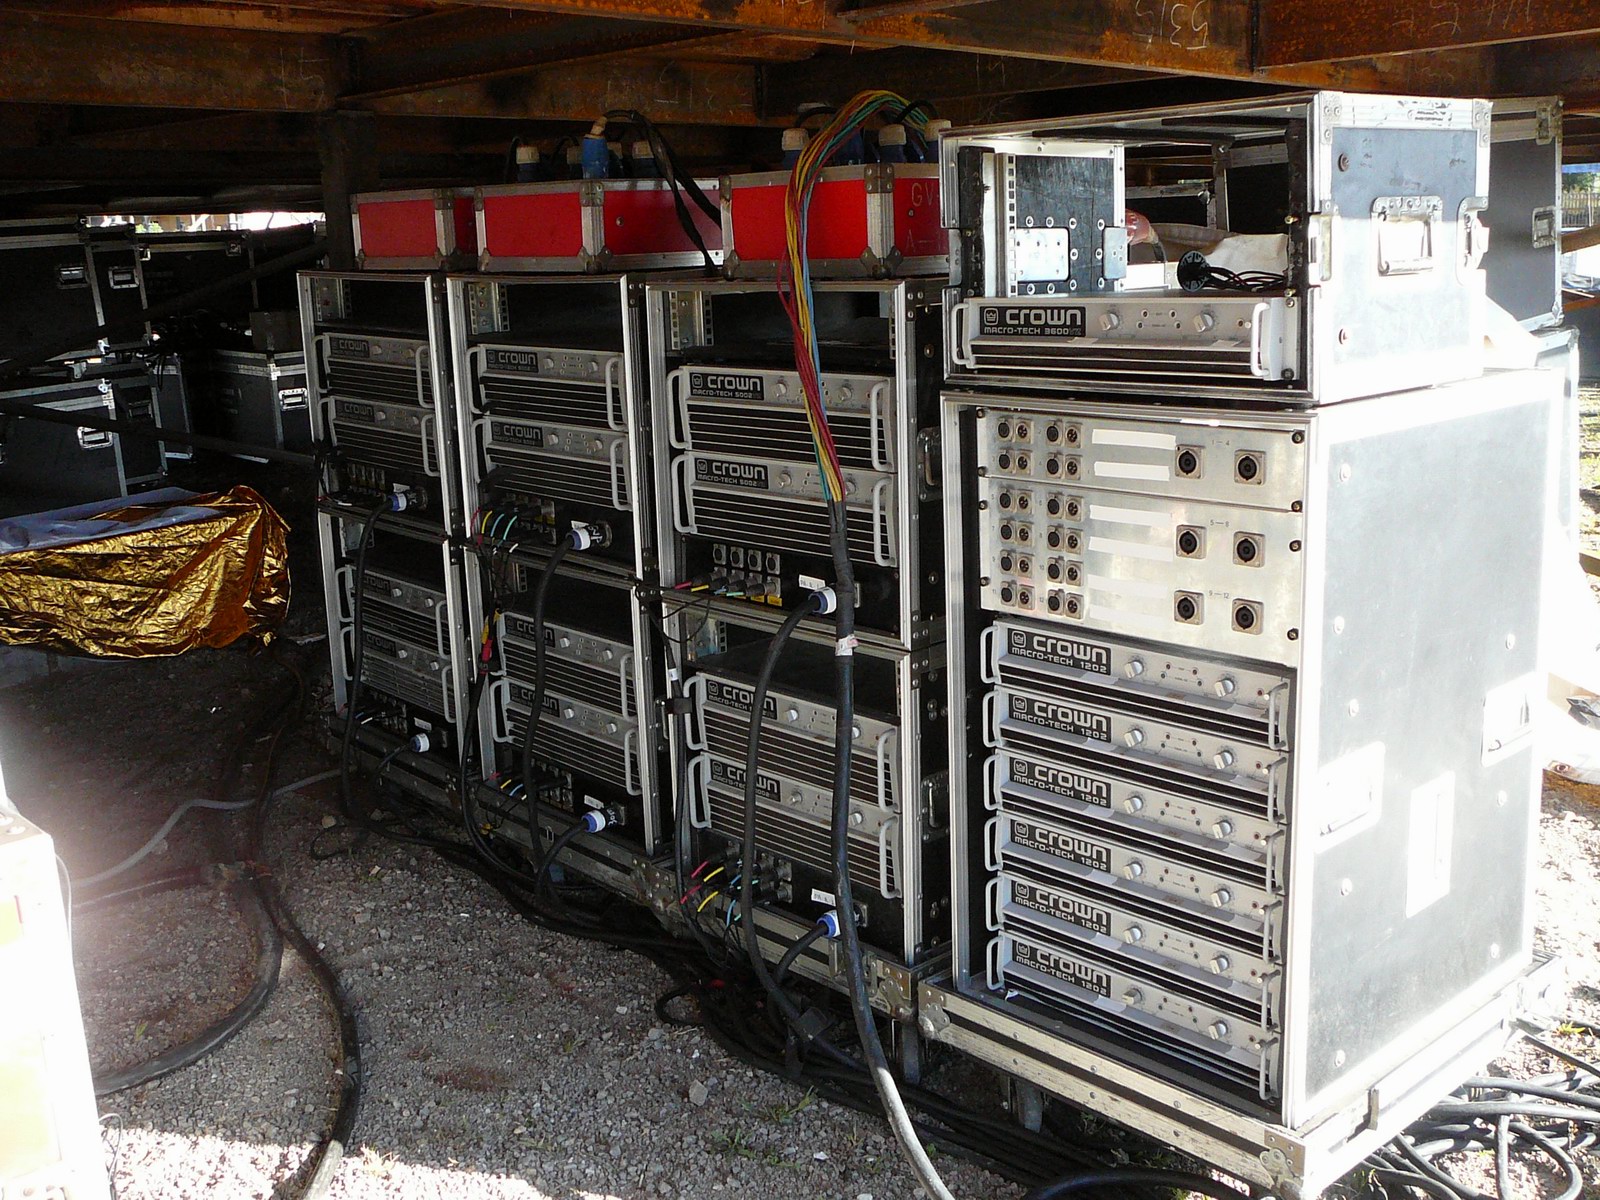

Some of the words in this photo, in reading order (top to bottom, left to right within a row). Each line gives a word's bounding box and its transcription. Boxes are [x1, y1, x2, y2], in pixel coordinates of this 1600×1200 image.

[984, 327, 1041, 335] MACRO-TECH
[692, 389, 733, 397] MACRO-TECH
[697, 474, 738, 485] MACRO-TECH
[1011, 646, 1074, 667] MACRO-TECH
[1080, 661, 1108, 674] 1202
[708, 695, 748, 711] MACRO-TECH
[1012, 711, 1075, 733] MACRO-TECH
[1081, 726, 1108, 740] 1202
[1013, 774, 1075, 798] MACRO-TECH
[1081, 791, 1107, 806] 1202
[1014, 836, 1075, 861] MACRO-TECH
[1081, 857, 1108, 871] 1202
[1014, 896, 1075, 923] MACRO-TECH
[1081, 919, 1108, 934] 1202
[1016, 956, 1076, 983] MACRO-TECH
[1081, 980, 1108, 995] 1202
